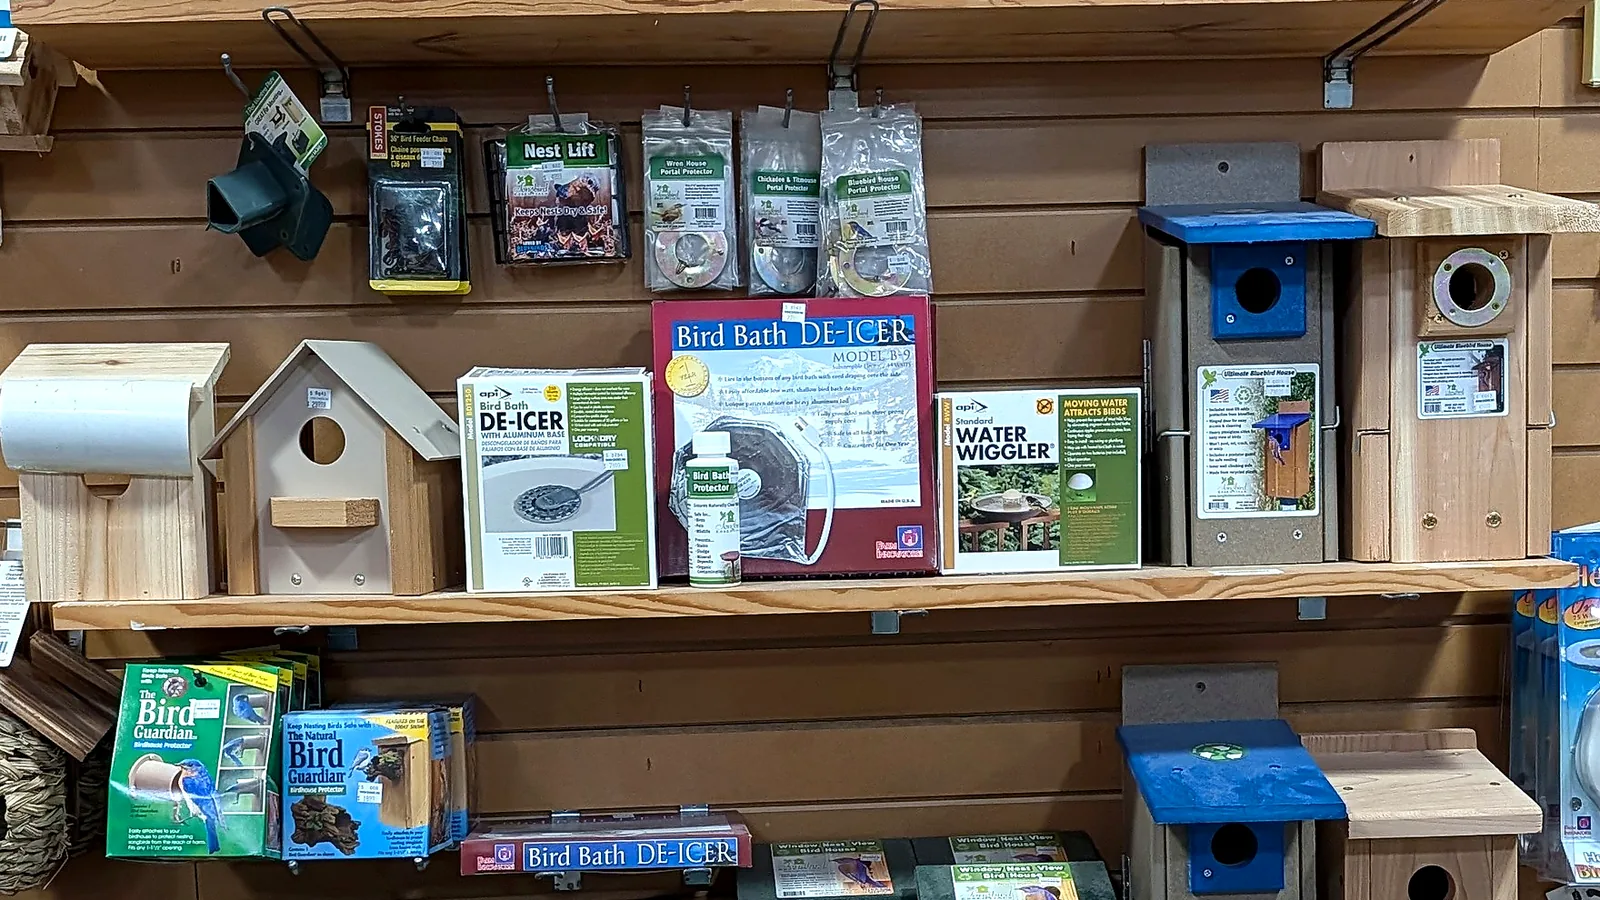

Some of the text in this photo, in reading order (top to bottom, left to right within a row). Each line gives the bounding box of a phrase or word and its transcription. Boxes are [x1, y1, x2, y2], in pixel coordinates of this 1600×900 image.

[374, 113, 383, 150] STOKES
[525, 142, 595, 158] Nest Lift
[848, 177, 876, 186] Bluebird
[870, 184, 900, 192] Protector
[516, 208, 538, 216] Keeps
[564, 207, 577, 216] Dry
[588, 206, 607, 214] Safe!
[677, 320, 910, 348] Bird Bath DE-ICER
[833, 350, 910, 362] MODEL B-9
[480, 389, 498, 398] api
[480, 401, 528, 410] Bird Bath
[955, 402, 975, 412] api
[1064, 408, 1101, 416] ATTRACTS
[480, 411, 564, 431] DE-ICER
[955, 417, 993, 425] Standard
[956, 426, 1027, 443] WATER
[693, 471, 708, 480] Bird
[693, 484, 729, 492] Protector
[139, 690, 156, 698] The
[136, 698, 197, 726] Bird
[134, 725, 194, 739] Guardian
[288, 731, 337, 740] The Natural
[288, 739, 345, 768] Bird
[288, 769, 346, 784] Guardian
[528, 842, 735, 868] Bird Bath DE-ICER
